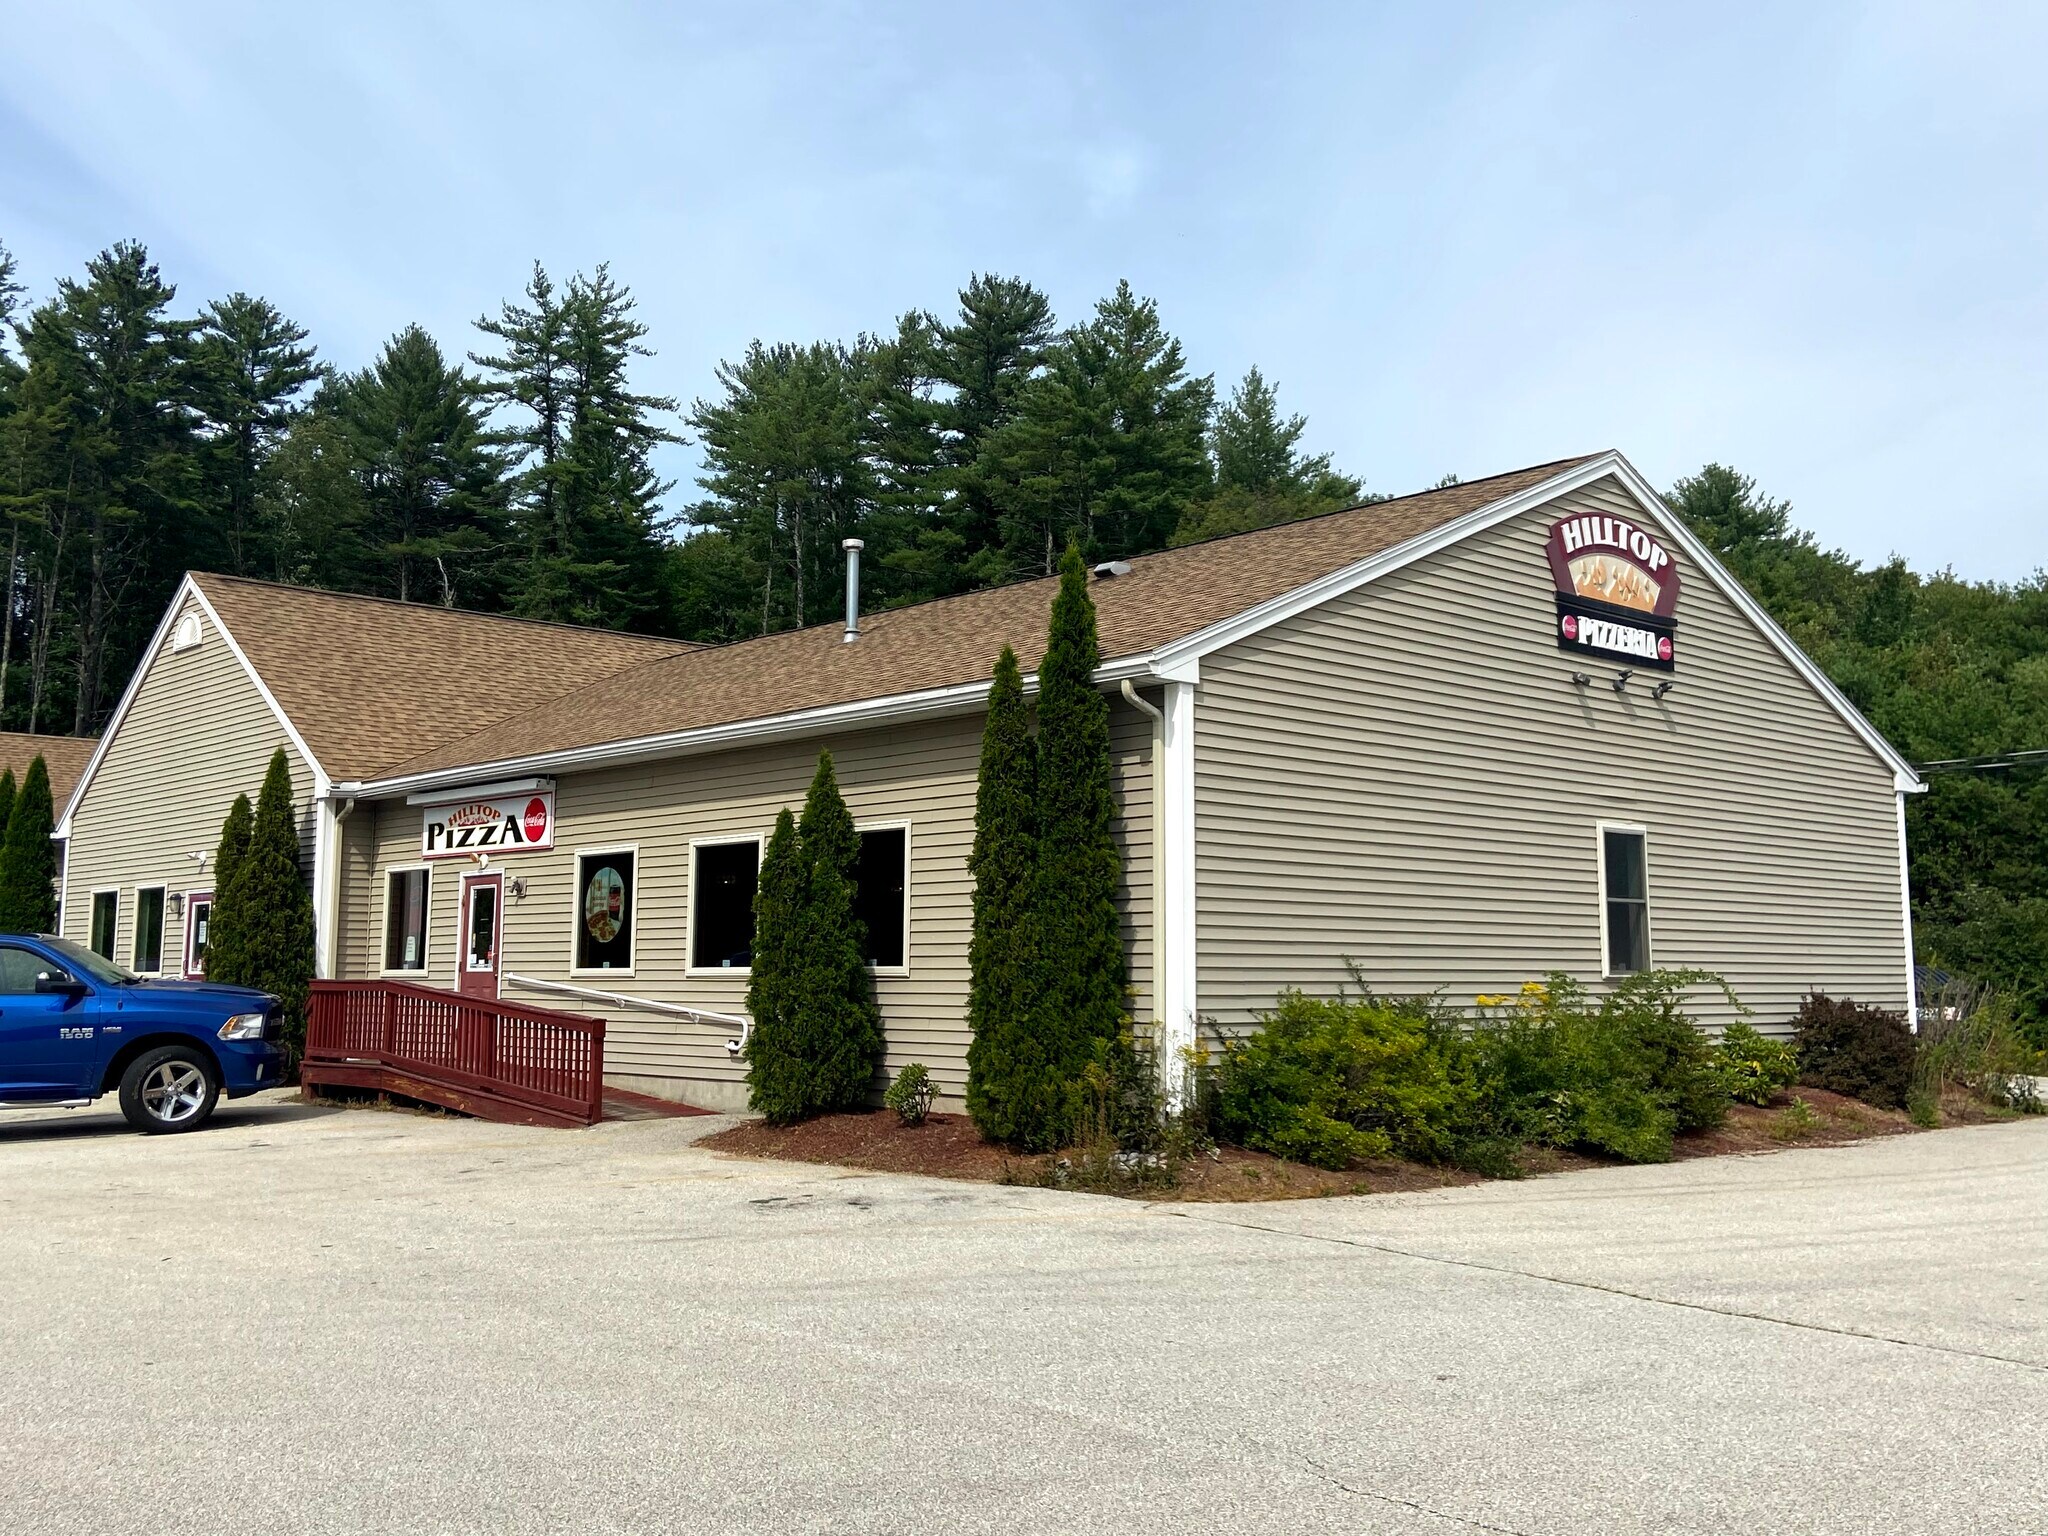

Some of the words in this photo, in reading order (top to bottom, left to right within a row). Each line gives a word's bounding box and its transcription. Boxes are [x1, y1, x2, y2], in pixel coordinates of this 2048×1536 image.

[1560, 516, 1668, 572] HILLTOP
[1577, 616, 1659, 660] PIZZERIA
[427, 815, 524, 850] PIZZA
[447, 804, 501, 827] HILLTOP
